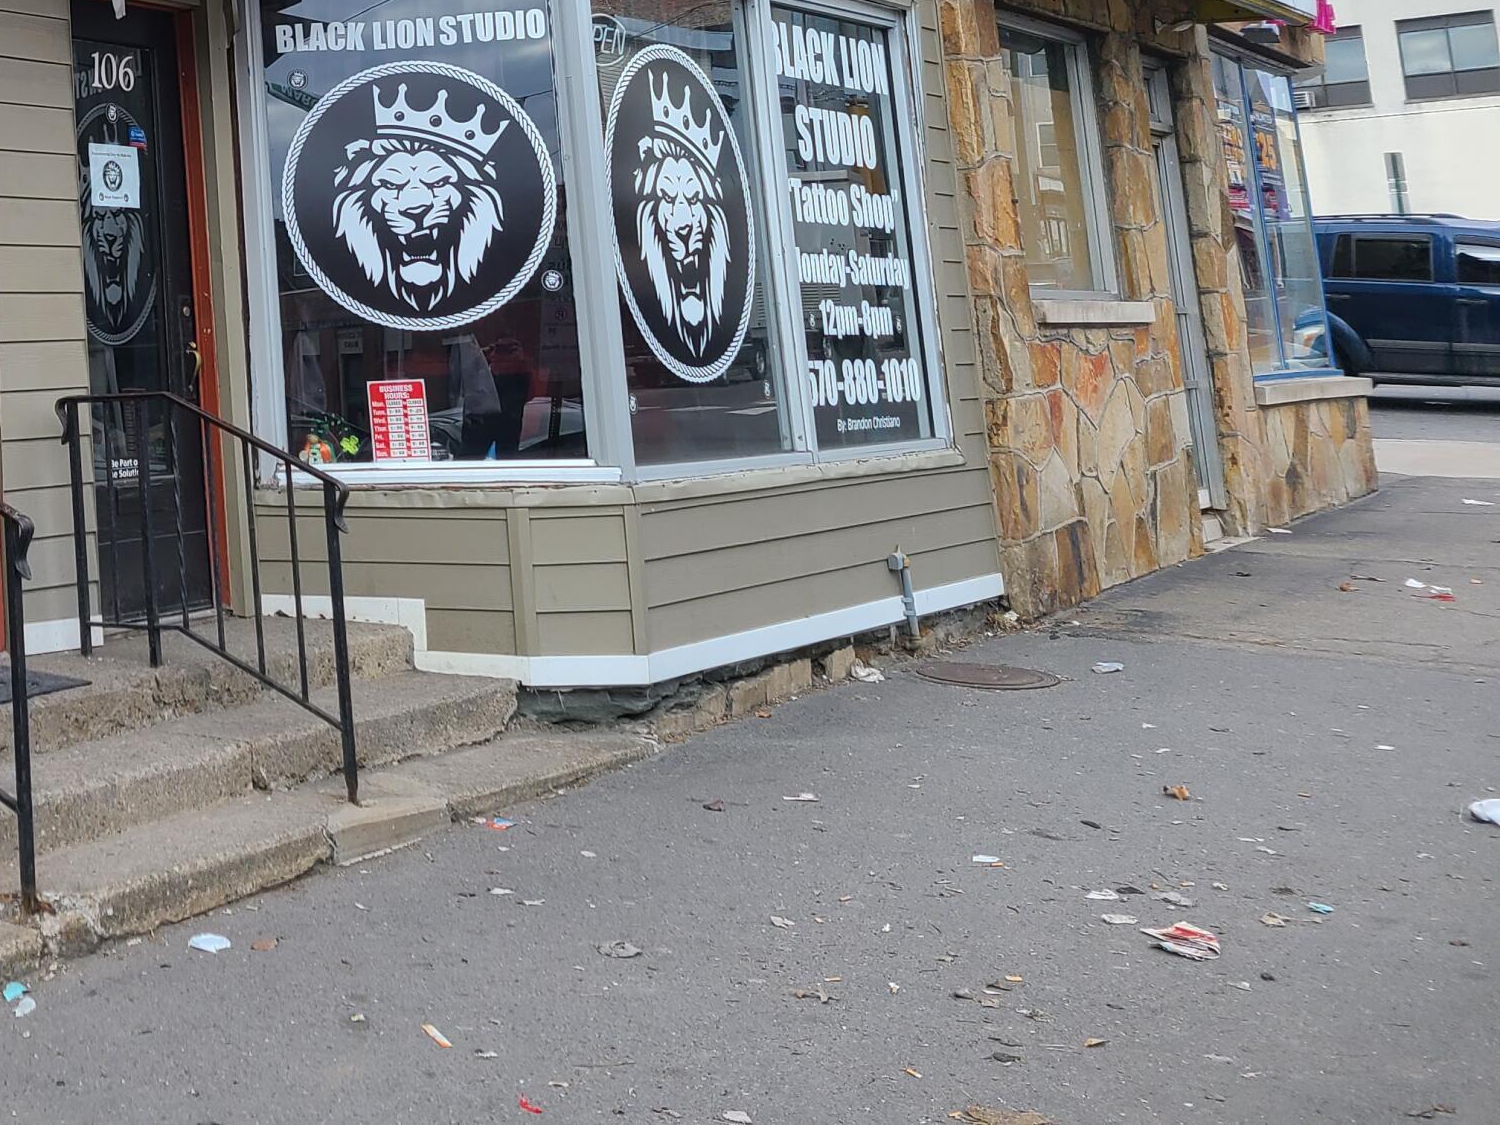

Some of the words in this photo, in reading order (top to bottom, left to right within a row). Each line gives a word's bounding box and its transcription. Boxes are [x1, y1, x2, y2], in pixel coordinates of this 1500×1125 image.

[275, 22, 365, 53] BLACK
[372, 18, 435, 51] LION
[439, 8, 546, 46] STUDIO
[593, 25, 626, 56] PEN
[91, 51, 135, 92] 106
[839, 35, 889, 95] LION
[795, 104, 878, 170] STUDIO
[819, 299, 894, 339] 12pm-8pm
[808, 357, 921, 407] 570-880-1010
